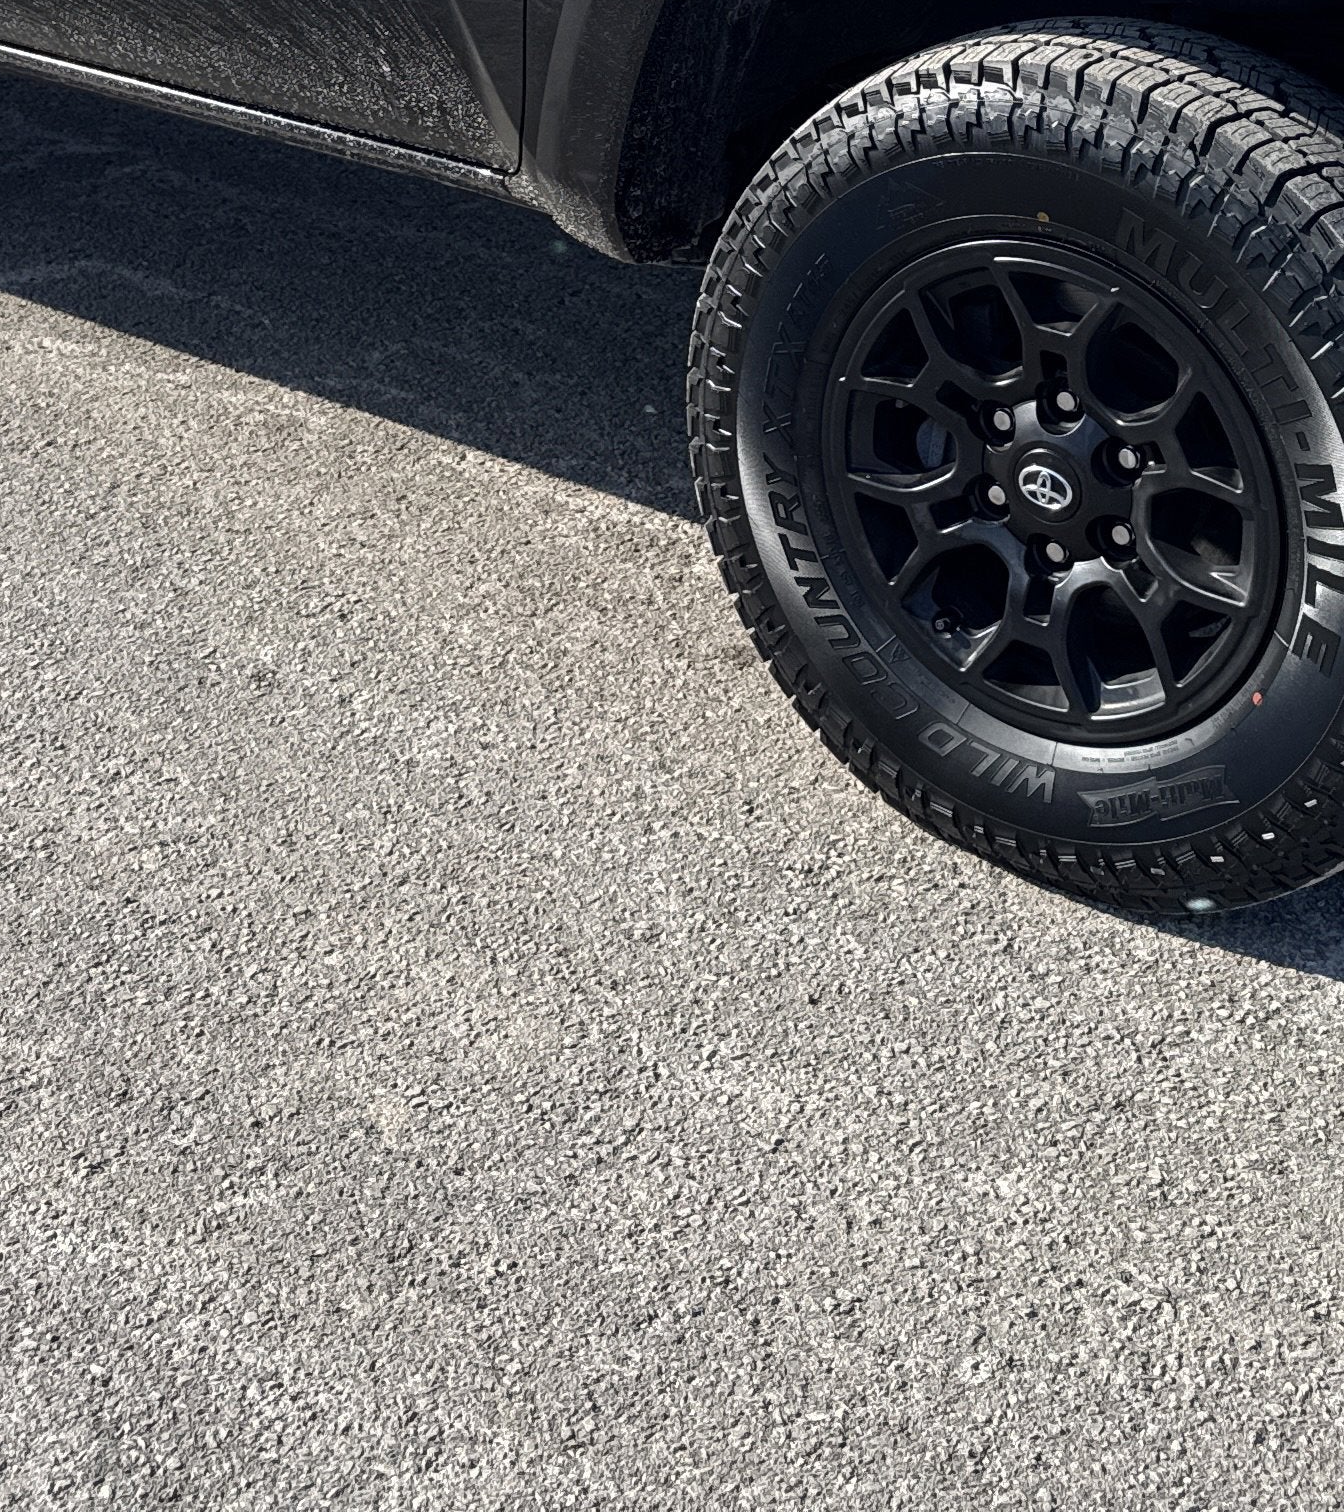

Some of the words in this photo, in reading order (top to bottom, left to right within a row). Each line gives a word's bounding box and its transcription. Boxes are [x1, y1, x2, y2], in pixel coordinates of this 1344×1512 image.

[763, 452, 921, 721] COUNTRY
[918, 723, 1057, 804] WILD
[1092, 776, 1226, 822] Multi-Mile
